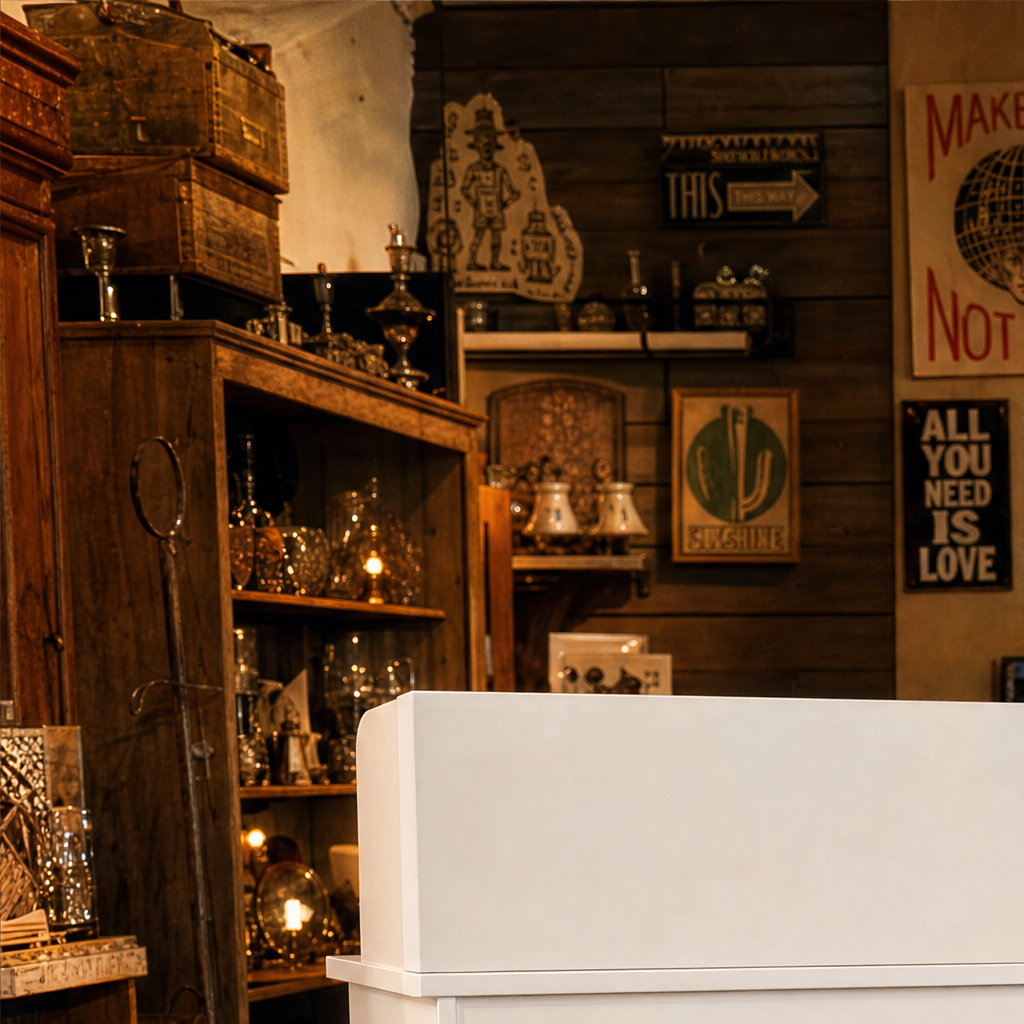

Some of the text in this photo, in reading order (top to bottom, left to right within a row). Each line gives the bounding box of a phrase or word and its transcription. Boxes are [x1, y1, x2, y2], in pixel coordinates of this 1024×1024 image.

[664, 170, 724, 220] THIS
[926, 265, 1016, 363] NOT
[920, 408, 991, 443] ALL
[920, 443, 992, 478] YOU
[923, 478, 993, 509] NEED
[931, 508, 982, 546] IS
[918, 545, 998, 583] LOVE
